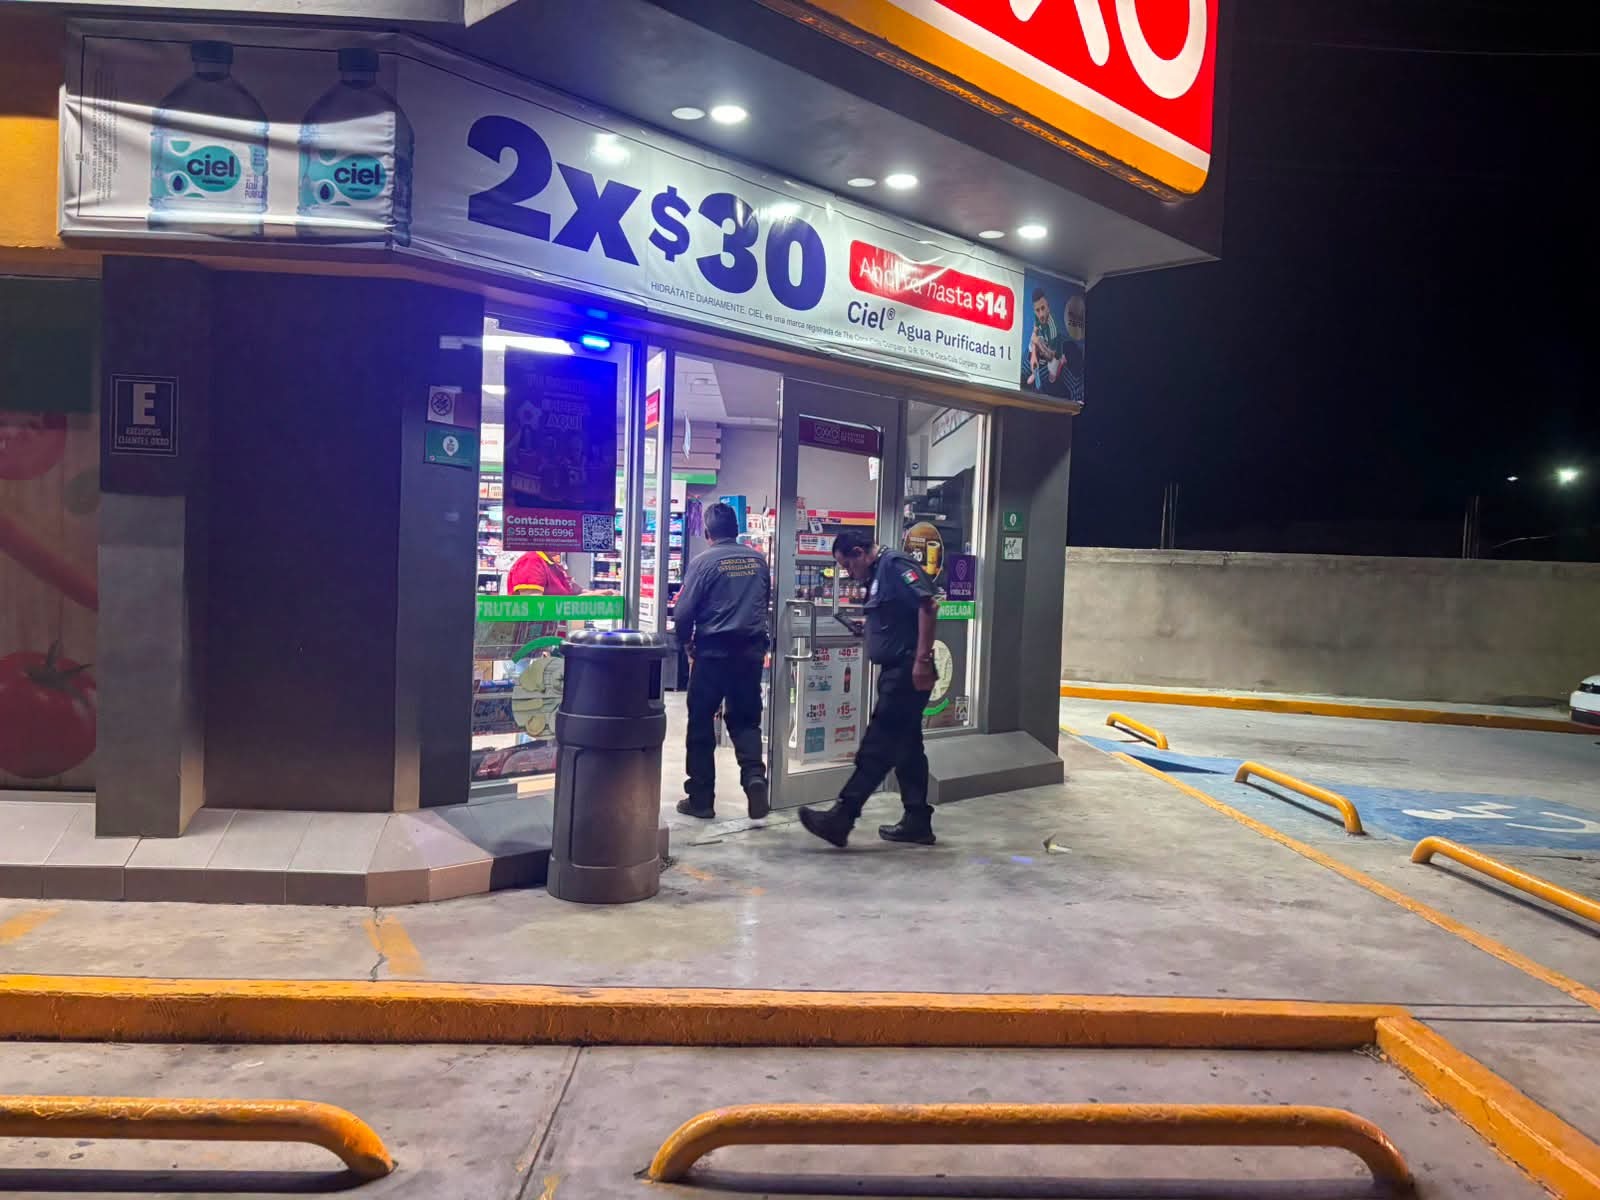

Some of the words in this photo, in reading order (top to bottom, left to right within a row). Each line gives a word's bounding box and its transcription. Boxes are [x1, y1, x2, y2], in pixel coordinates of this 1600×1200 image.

[187, 154, 237, 177] ciel
[334, 161, 381, 186] ciel
[927, 282, 973, 309] hasta
[976, 291, 1007, 319] $14
[748, 307, 764, 319] CIEL
[765, 313, 773, 322] es
[774, 315, 786, 325] una
[786, 318, 806, 330] marca
[806, 323, 835, 336] registrada
[835, 329, 842, 337] de
[897, 321, 931, 342] Agua
[935, 330, 996, 356] Purificada
[1000, 346, 1006, 359] 1
[133, 383, 156, 424] E
[506, 515, 577, 527] Contáctanos:
[515, 527, 527, 536] 55
[528, 528, 550, 537] 8526
[552, 529, 574, 537] 6996
[477, 600, 528, 617] FRUTAS
[538, 602, 545, 617] Y
